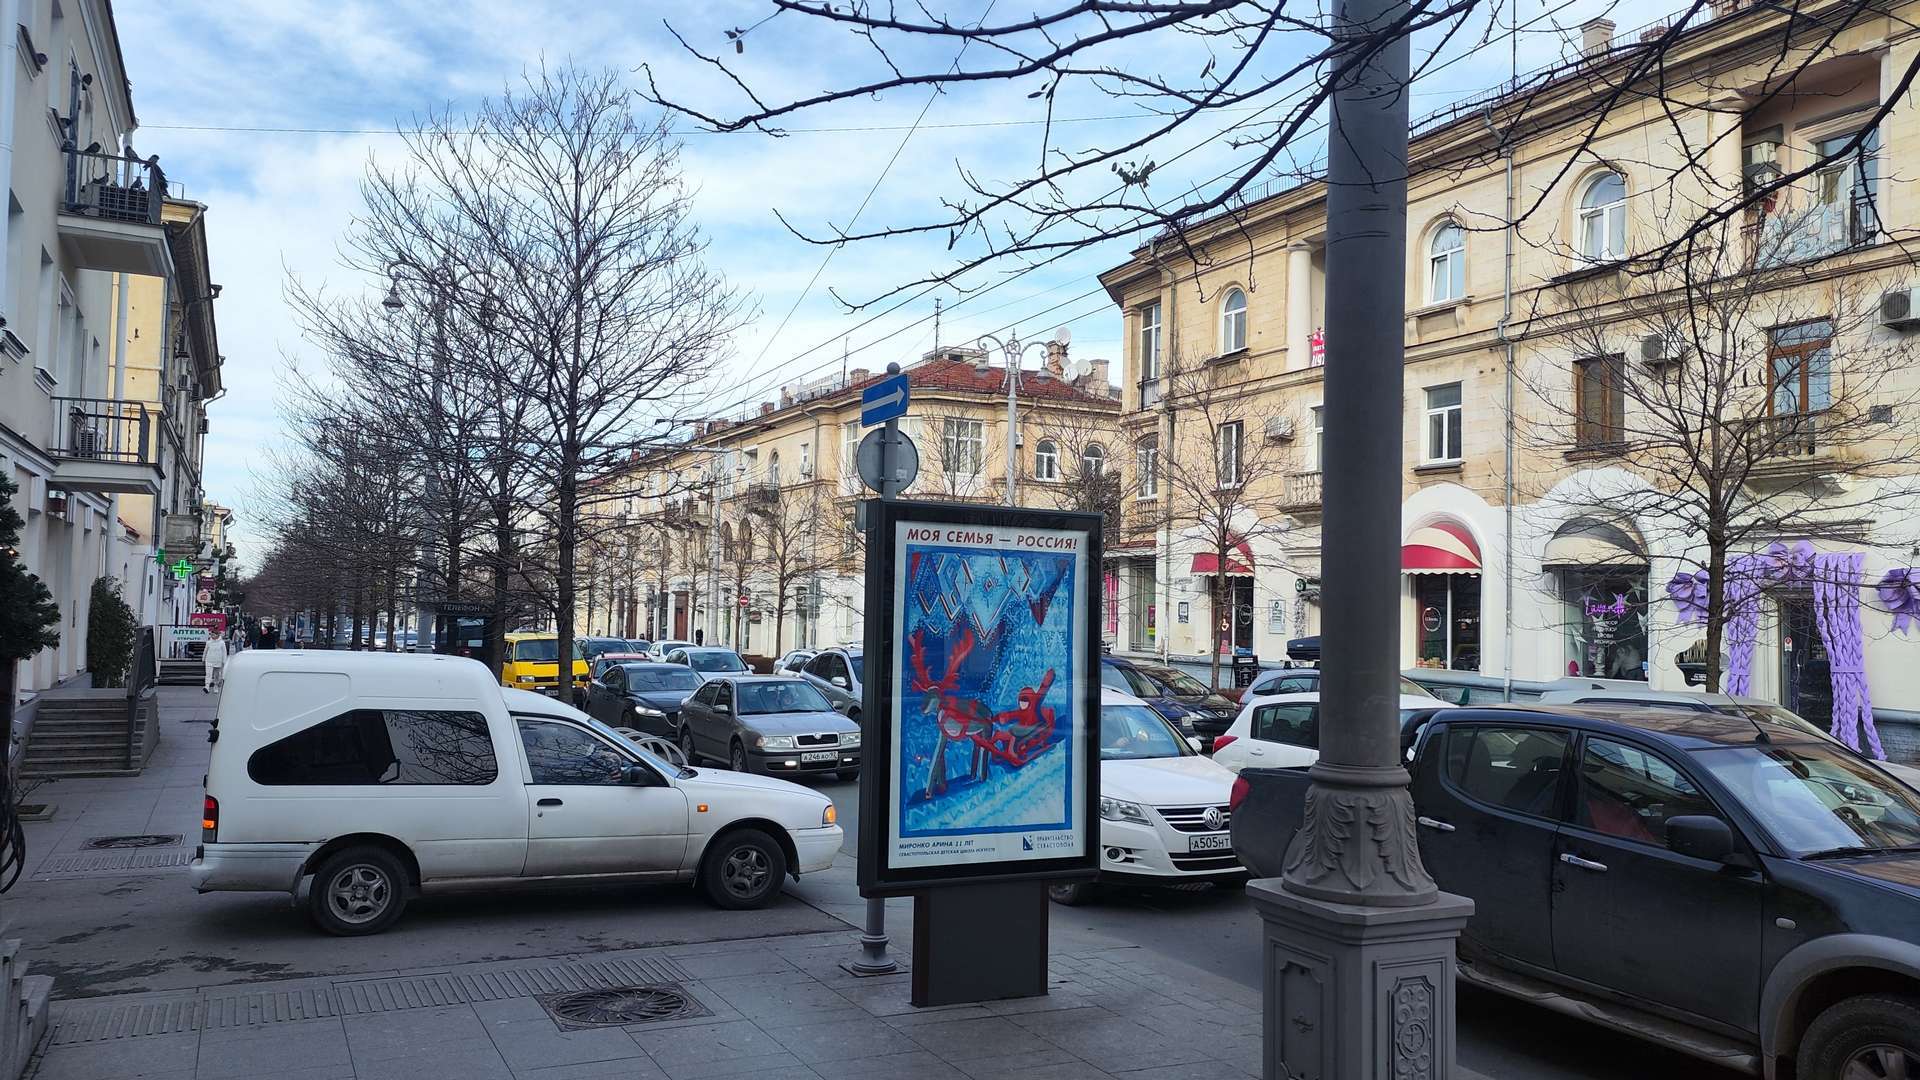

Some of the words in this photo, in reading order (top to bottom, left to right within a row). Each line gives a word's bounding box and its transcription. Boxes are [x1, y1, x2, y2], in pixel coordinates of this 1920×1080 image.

[907, 528, 940, 542] МОЯ
[946, 530, 993, 545] СЕМЬЯ
[1016, 535, 1077, 549] РОССИЯ!
